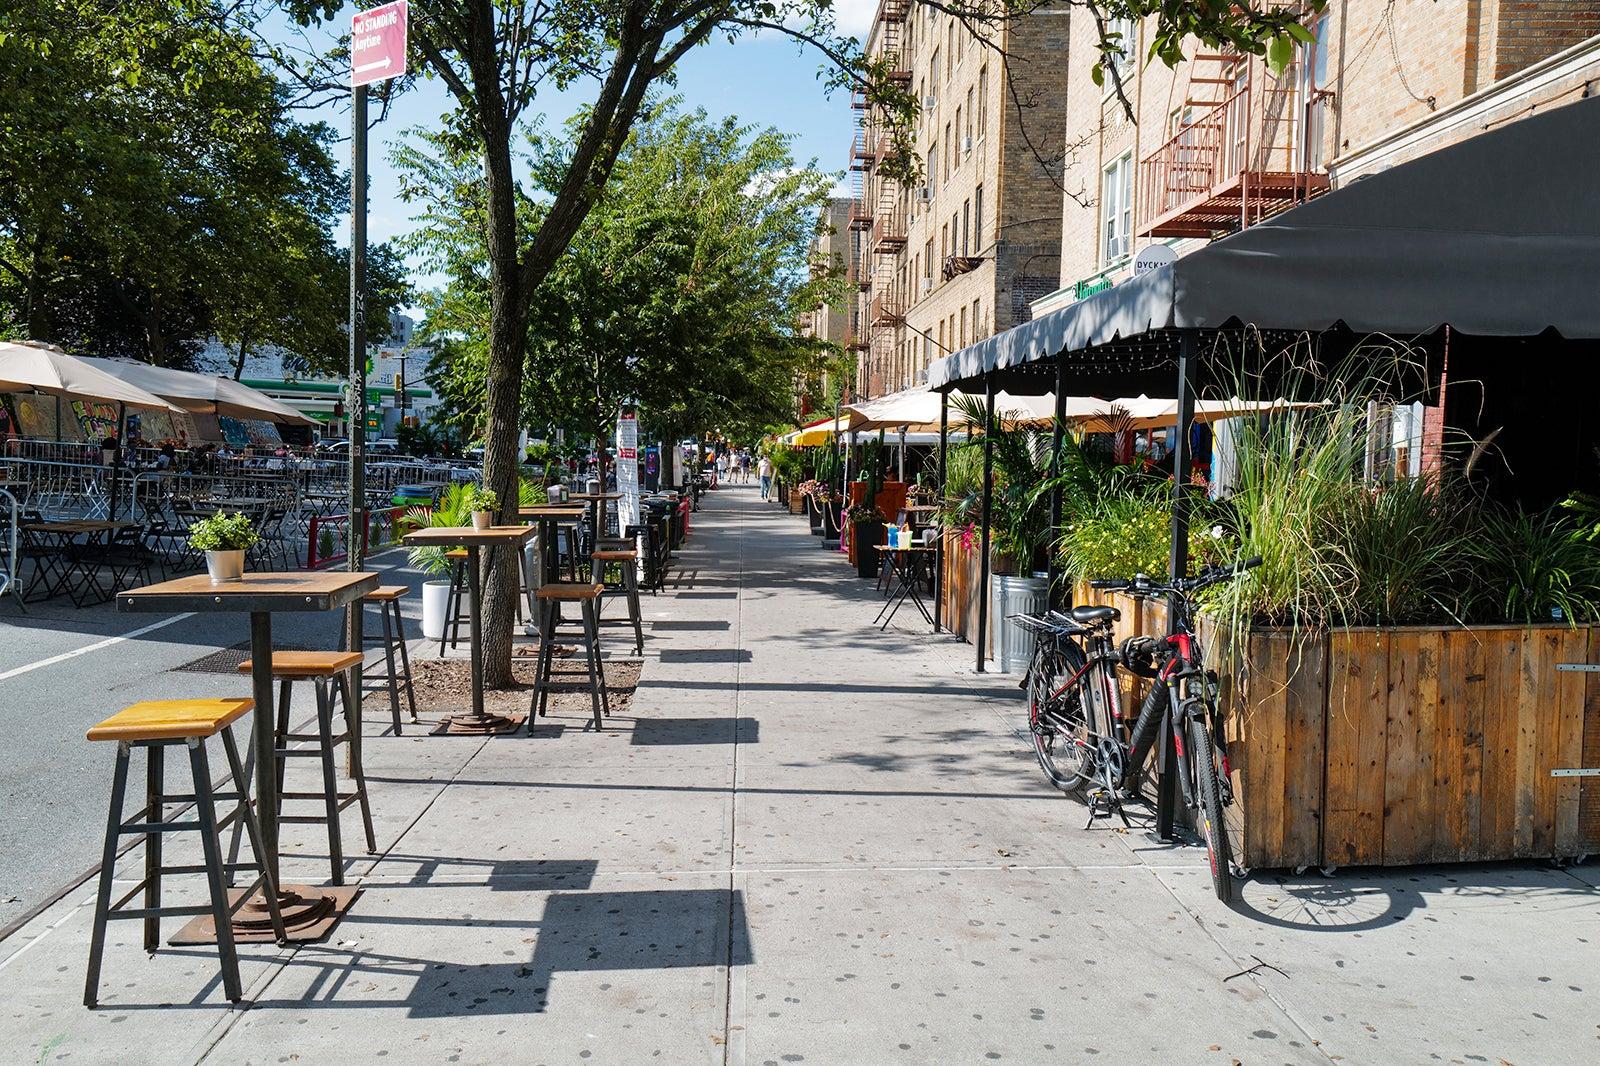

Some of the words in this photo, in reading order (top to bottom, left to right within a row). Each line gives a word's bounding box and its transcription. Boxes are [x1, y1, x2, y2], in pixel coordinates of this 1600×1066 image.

[355, 21, 364, 35] NO
[365, 10, 397, 32] STANDING
[355, 34, 381, 52] Anytime
